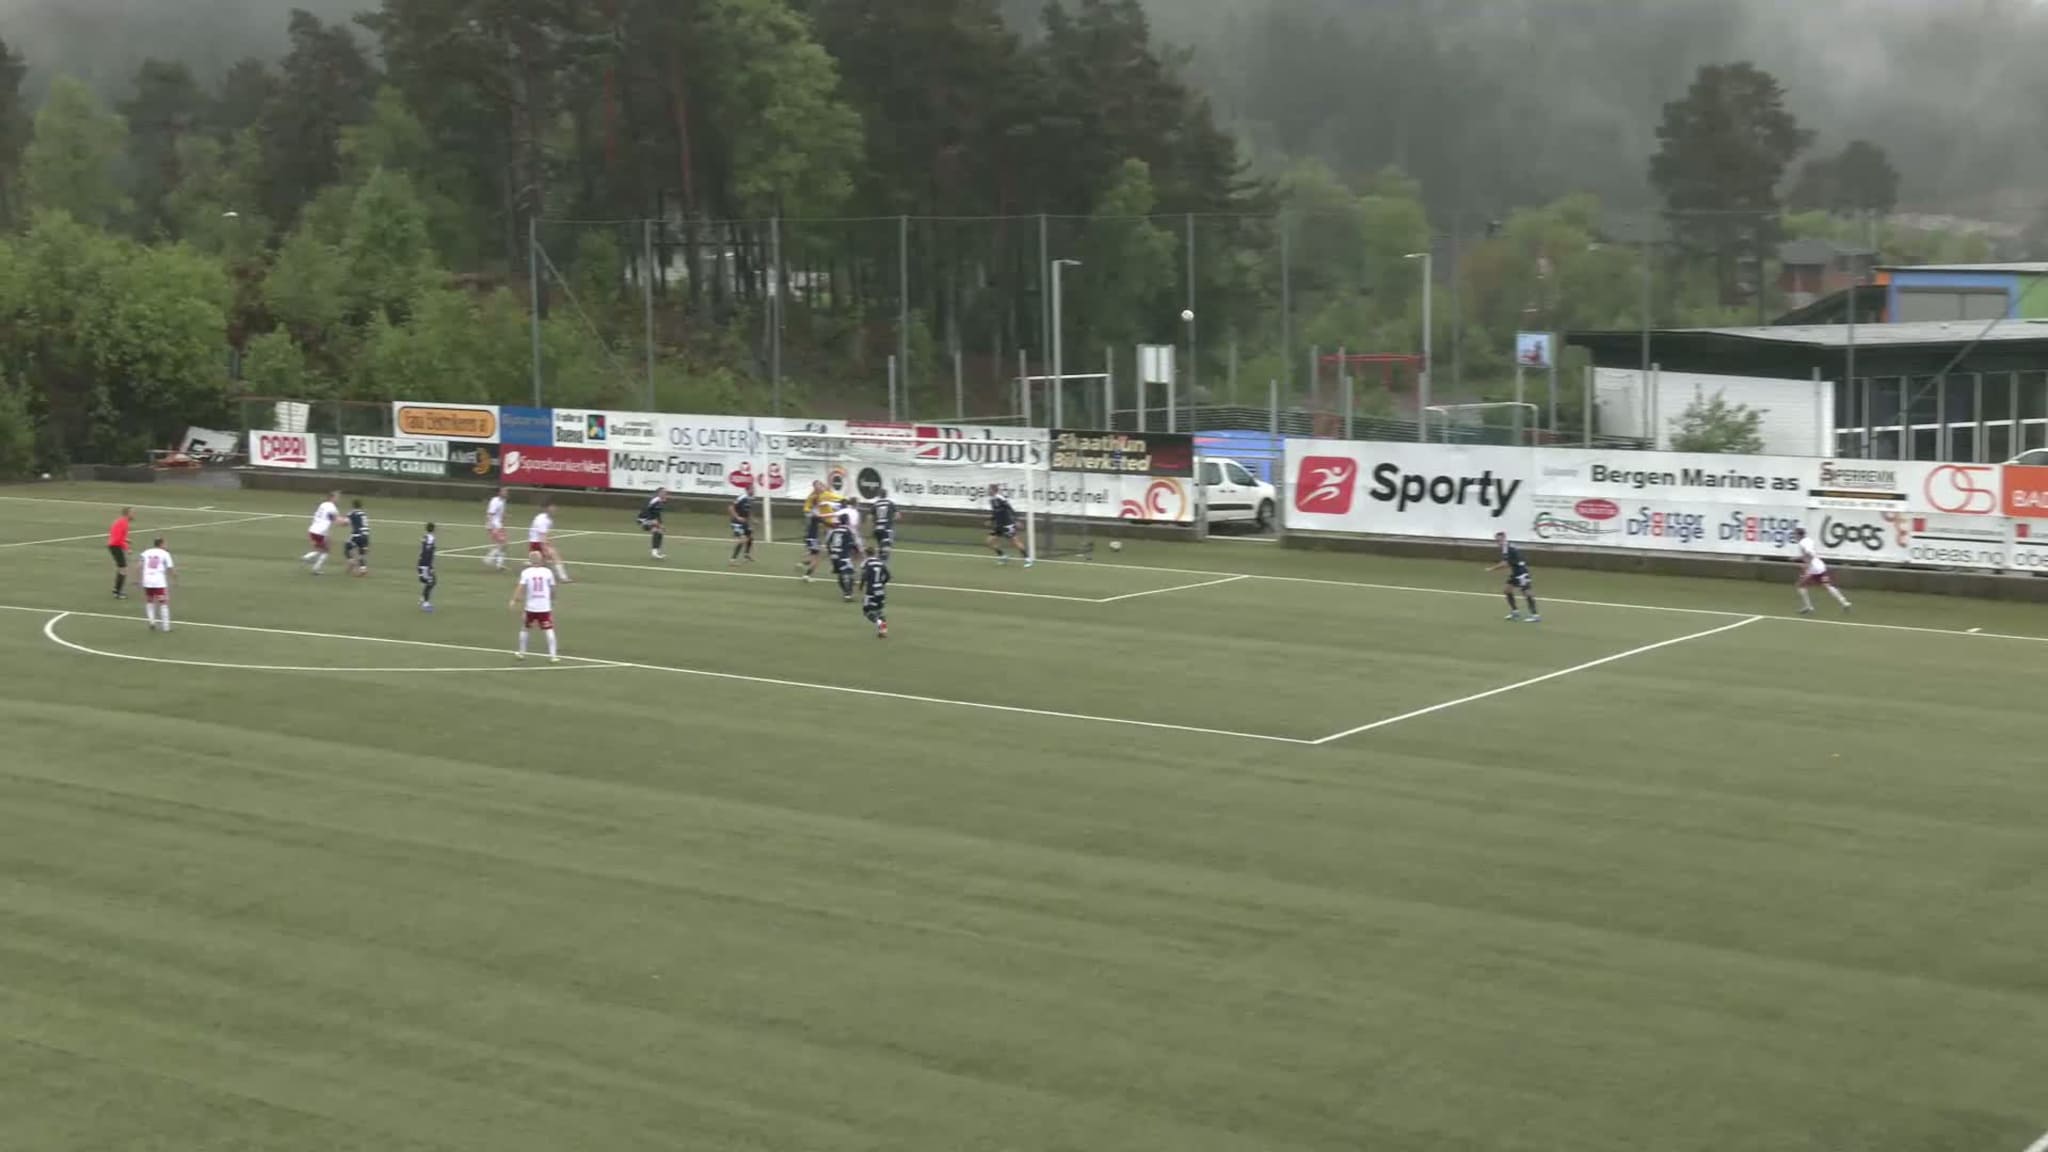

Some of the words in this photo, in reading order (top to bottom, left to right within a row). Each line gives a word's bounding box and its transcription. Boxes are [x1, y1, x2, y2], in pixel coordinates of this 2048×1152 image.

[670, 427, 692, 446] OS
[349, 438, 396, 455] PETER
[415, 442, 445, 459] PAN
[1591, 464, 1676, 488] Bergen
[1682, 468, 1765, 488] Marine
[1772, 476, 1799, 491] as
[926, 480, 990, 502] løsninge
[1370, 462, 1523, 517] Sporty
[1639, 506, 1705, 526] Sartor
[1731, 511, 1801, 530] Sartor
[1626, 518, 1705, 543] Drange
